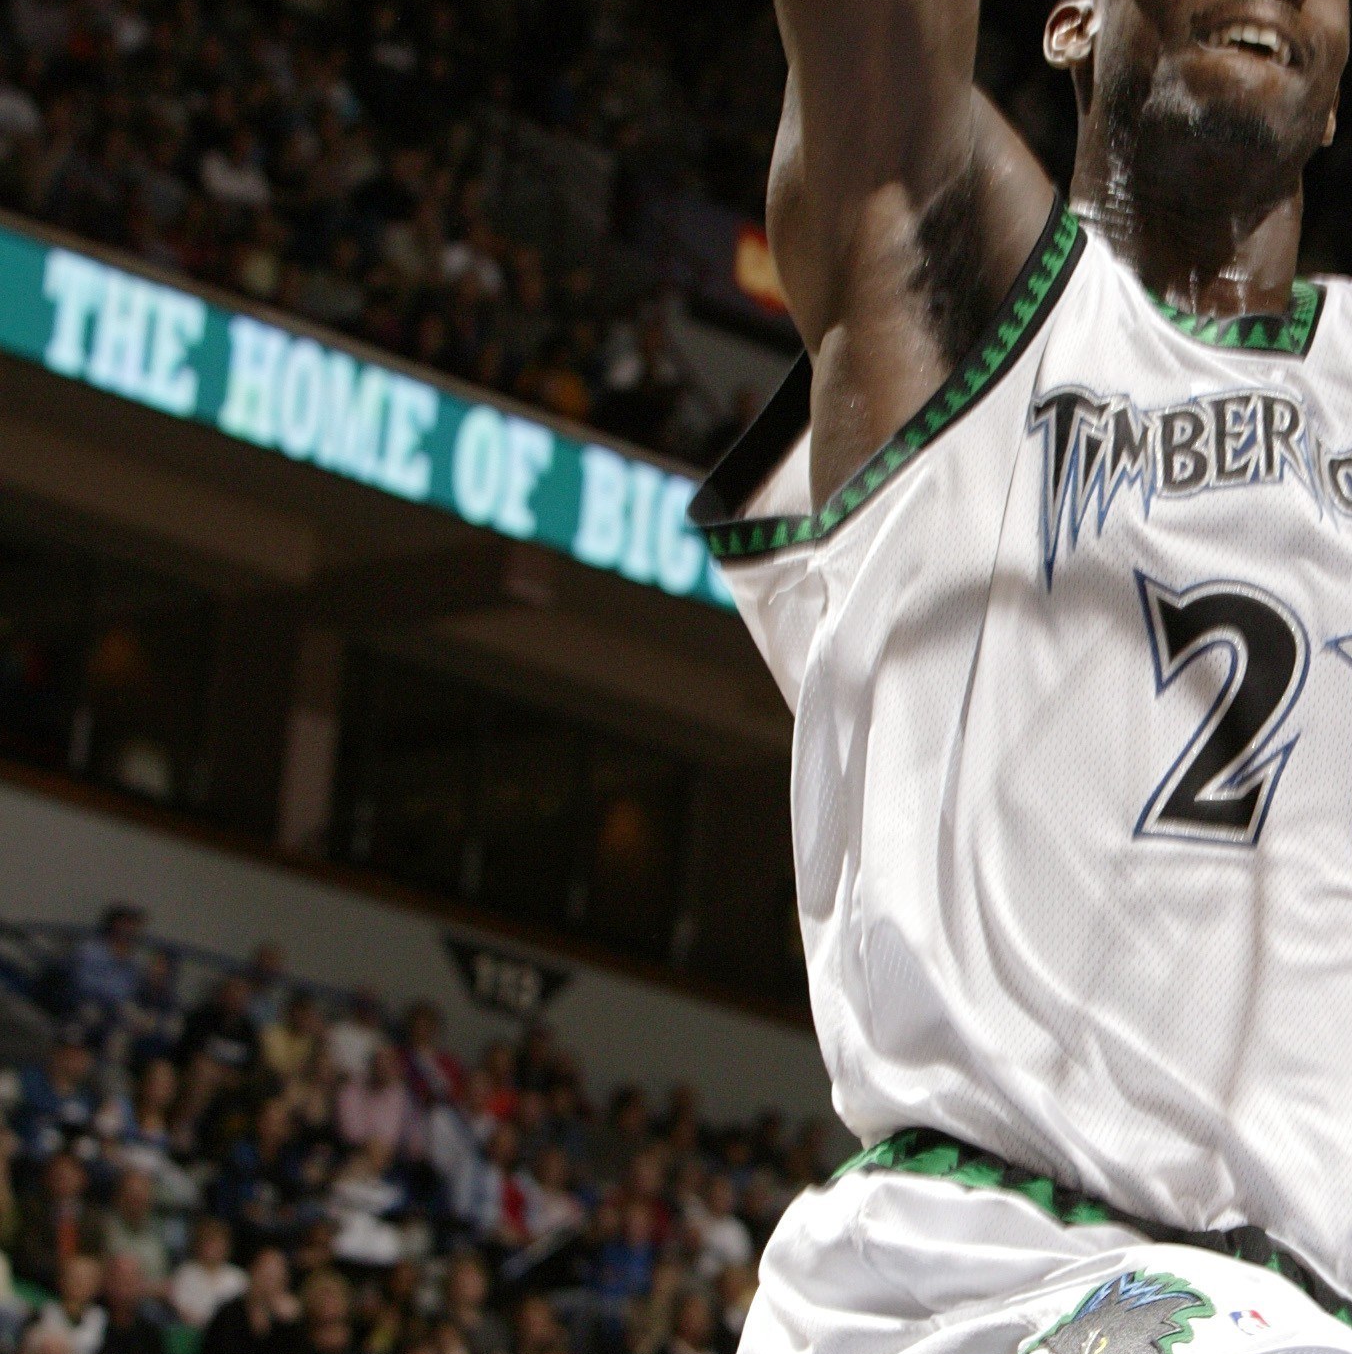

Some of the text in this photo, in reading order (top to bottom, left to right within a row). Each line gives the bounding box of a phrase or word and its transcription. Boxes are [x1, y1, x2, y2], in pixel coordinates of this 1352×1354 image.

[44, 246, 703, 597] THE HOME OF BIG
